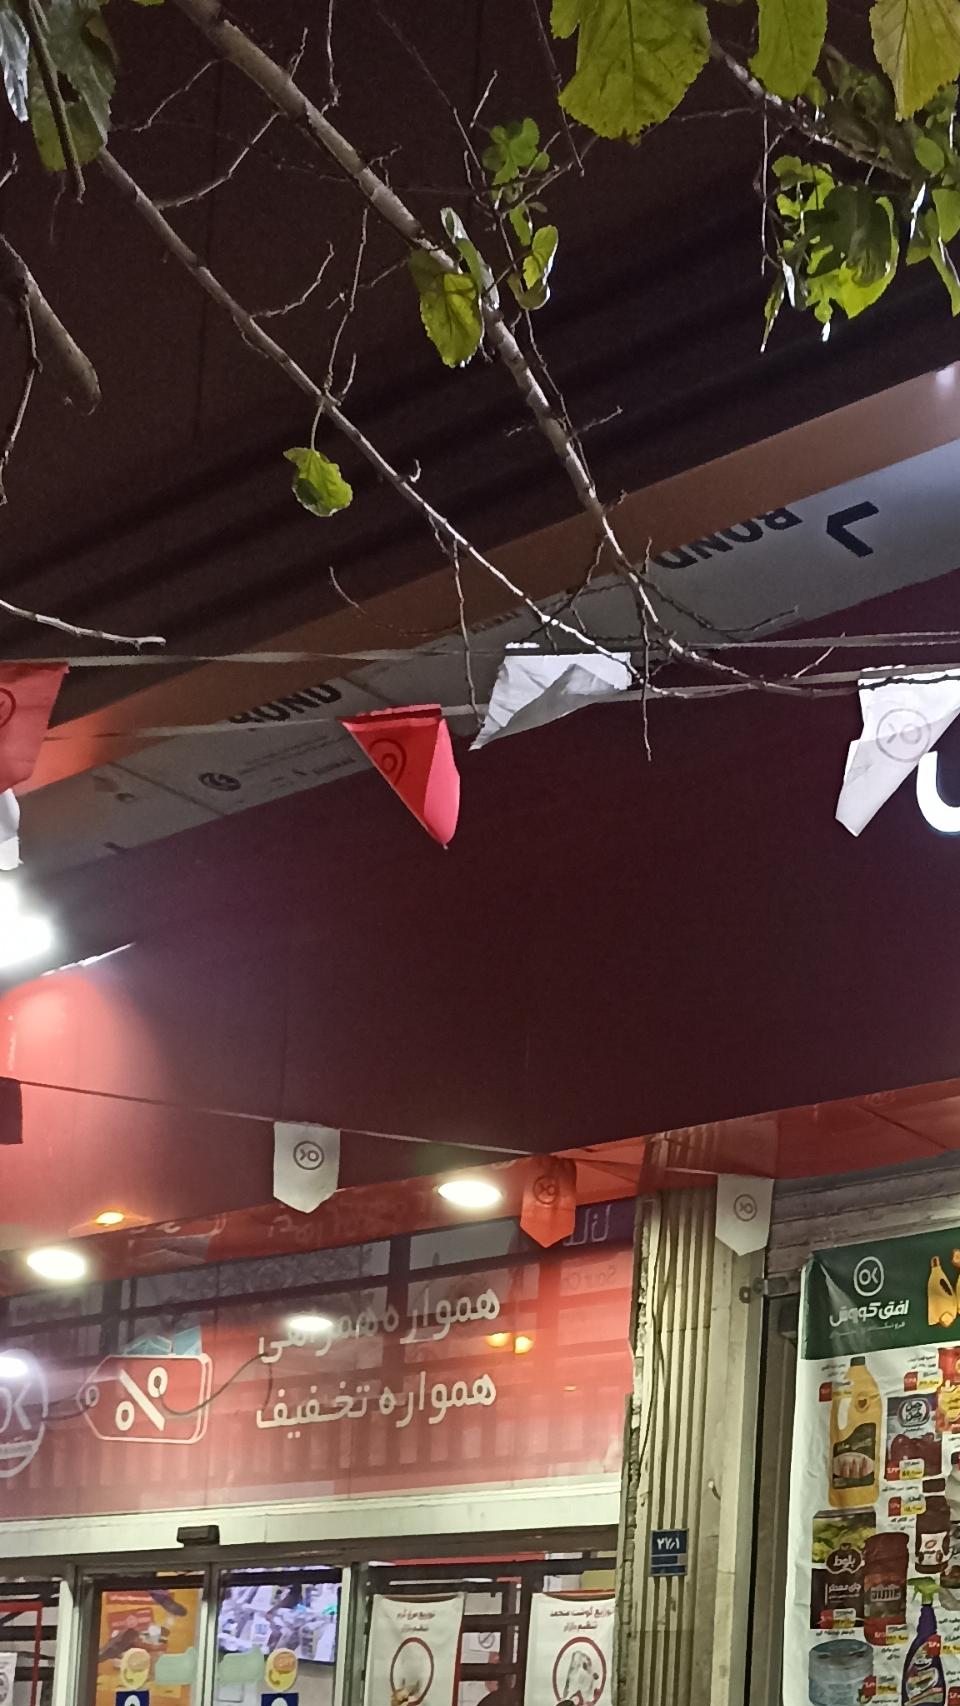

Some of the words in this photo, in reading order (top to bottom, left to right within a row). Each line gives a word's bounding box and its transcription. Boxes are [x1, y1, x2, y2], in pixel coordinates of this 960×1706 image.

[383, 1287, 501, 1345] همواره
[879, 1299, 909, 1320] افق
[256, 1380, 371, 1439] تخفیف
[378, 1371, 497, 1429] همواره
